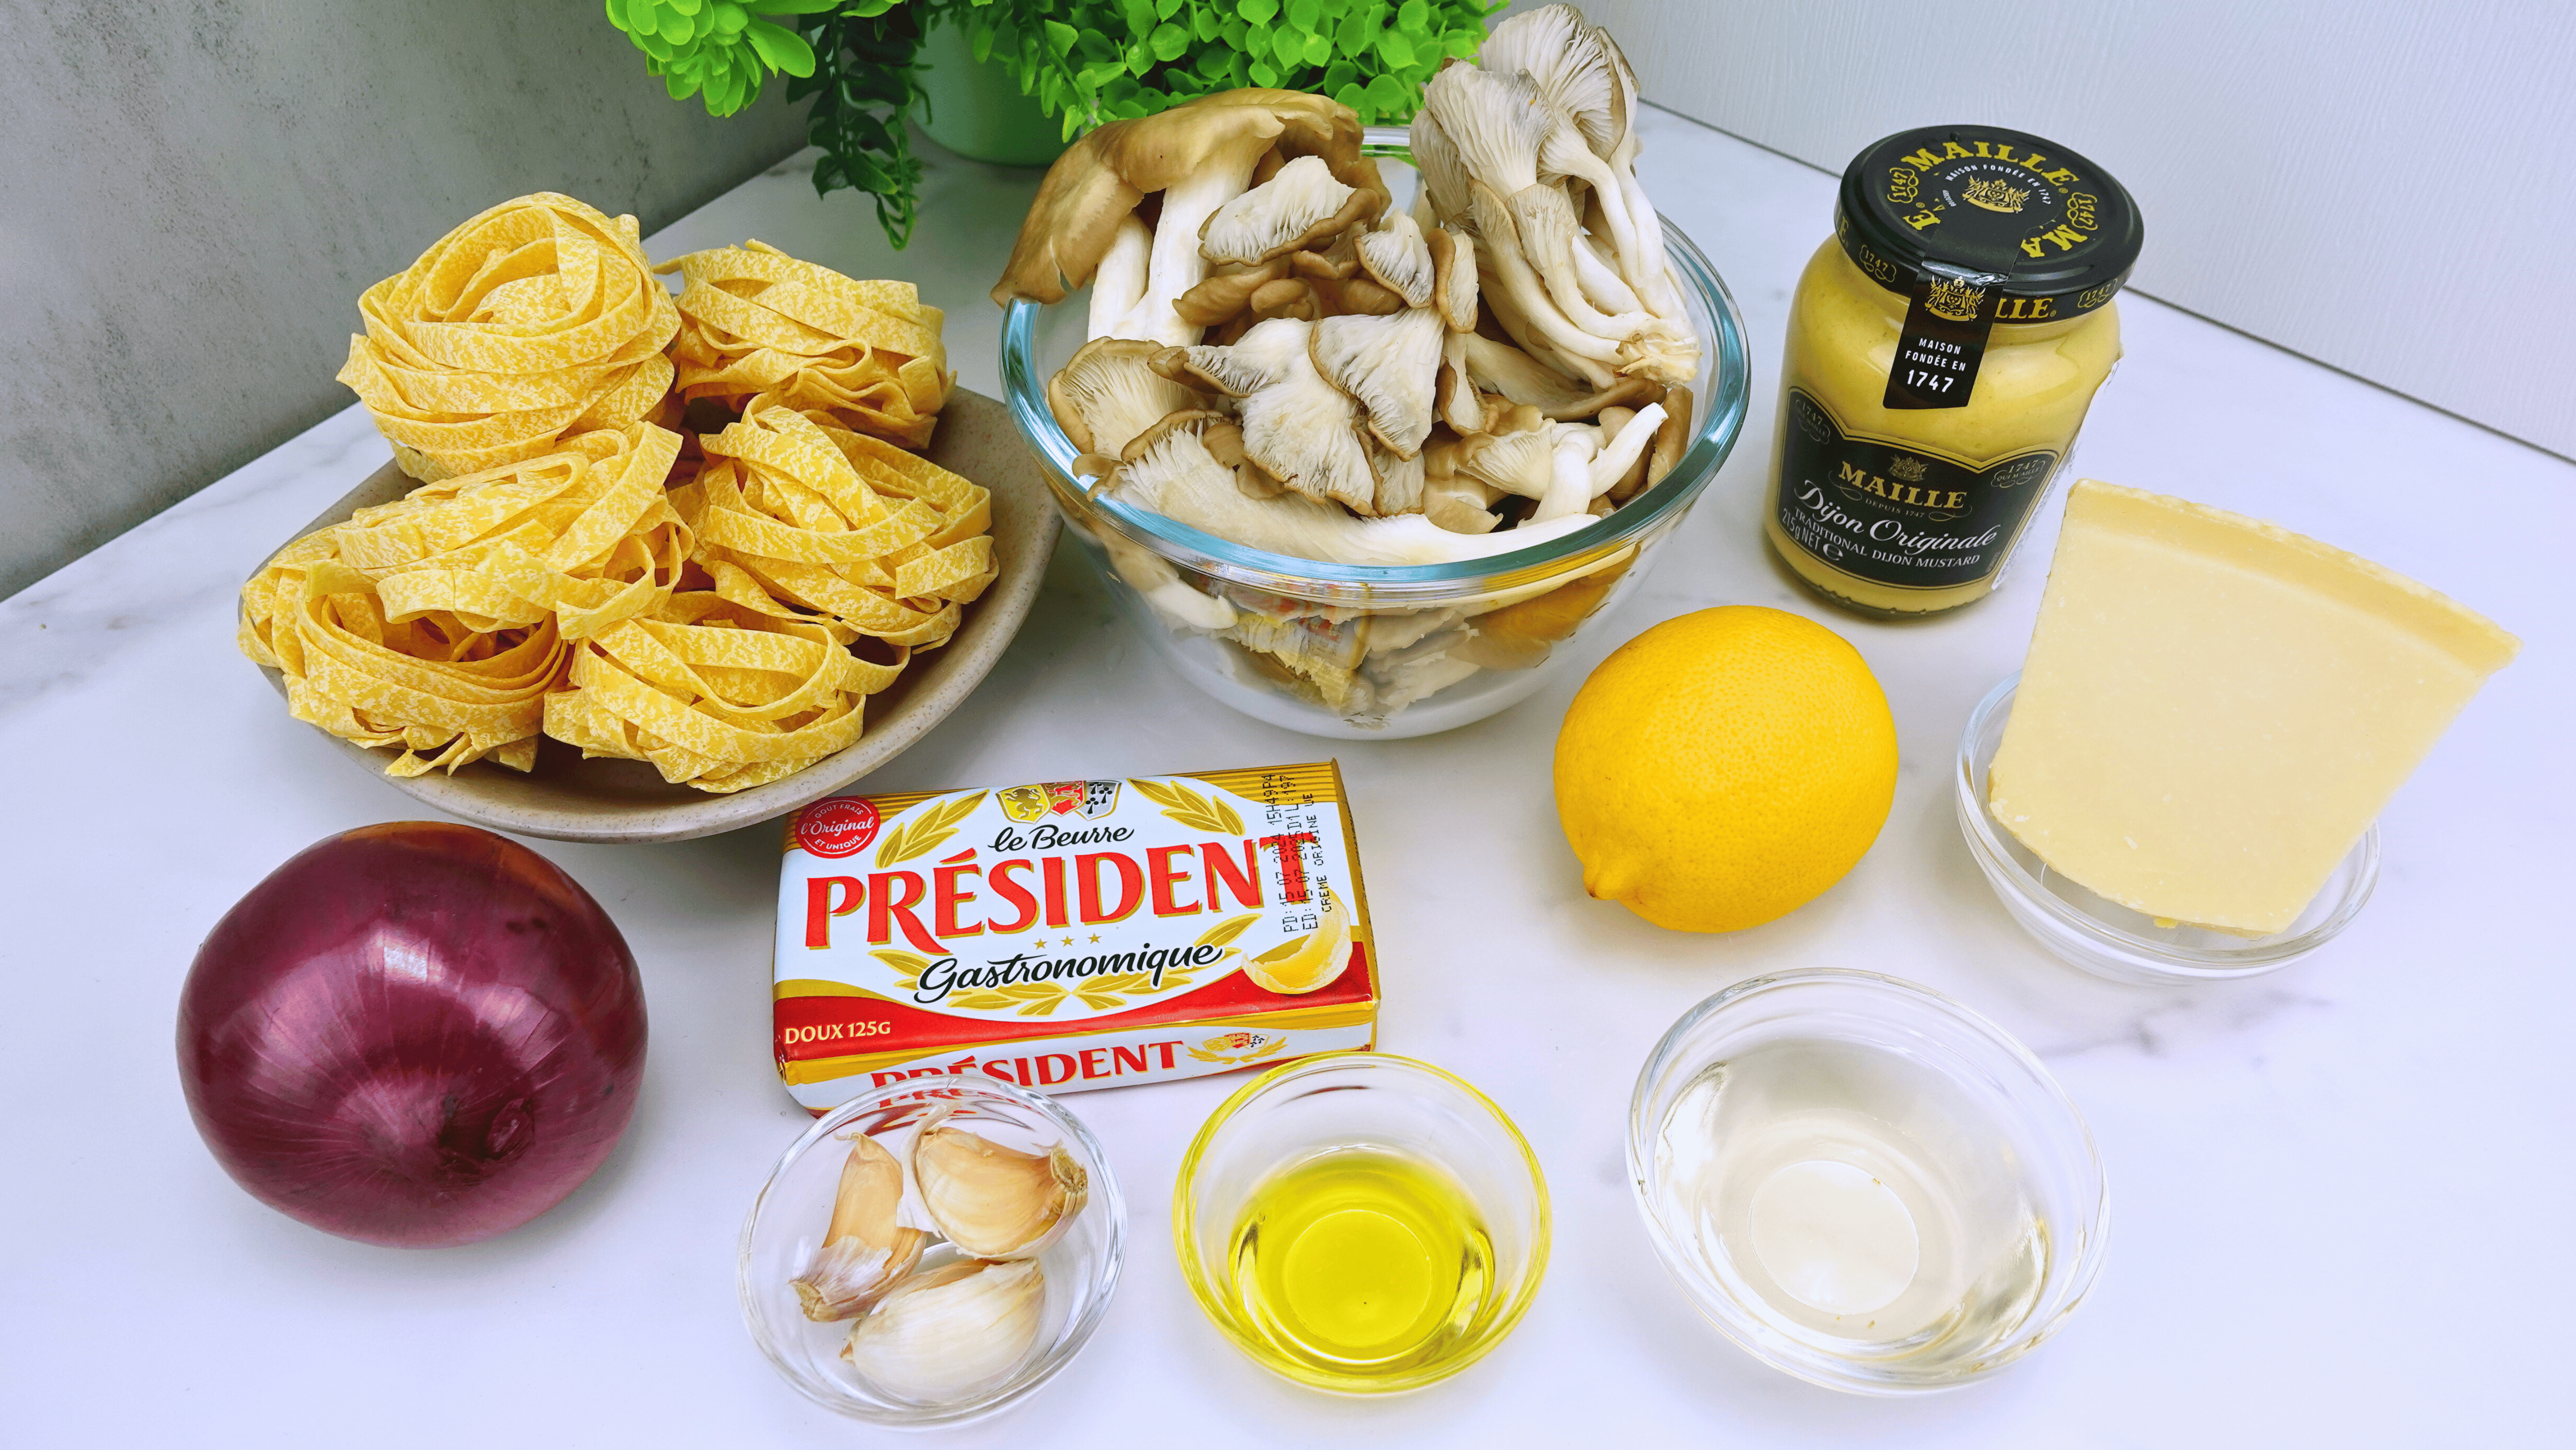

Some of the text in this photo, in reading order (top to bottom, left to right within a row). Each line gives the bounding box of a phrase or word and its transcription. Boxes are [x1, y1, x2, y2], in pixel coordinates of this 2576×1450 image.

[1900, 142, 2080, 186] MAILLE
[1891, 172, 1908, 197] 1747
[1946, 165, 1978, 181] MAISON
[2028, 178, 2041, 187] EN
[2039, 189, 2051, 204] 1747
[2078, 199, 2095, 226] 1747
[1865, 250, 1888, 272] 1747
[2086, 283, 2111, 301] 1747
[1919, 338, 1961, 354] MAISON
[1905, 350, 1966, 371] FONDÉE EN
[1908, 370, 1954, 393] 1747
[2009, 459, 2039, 473] 1747
[1838, 461, 1967, 508] MAILLE
[1794, 479, 2001, 556] Dijon Originale
[1866, 498, 1901, 514] DEPUIS
[1782, 508, 1821, 550] 215g NET
[1795, 507, 1867, 556] TRADITIONAL
[1872, 550, 1912, 565] DIJON
[1916, 555, 1980, 568] MUSTARD
[840, 804, 864, 815] FRAIS
[801, 816, 874, 837] l'Original
[988, 824, 1135, 853] le Beurre
[826, 835, 862, 850] UNIQUE
[805, 832, 1318, 954] PRÉSIDENT
[1316, 875, 1332, 912] CREME
[913, 942, 1223, 1004] Gastronomique
[785, 1021, 890, 1044] DOUX 125G
